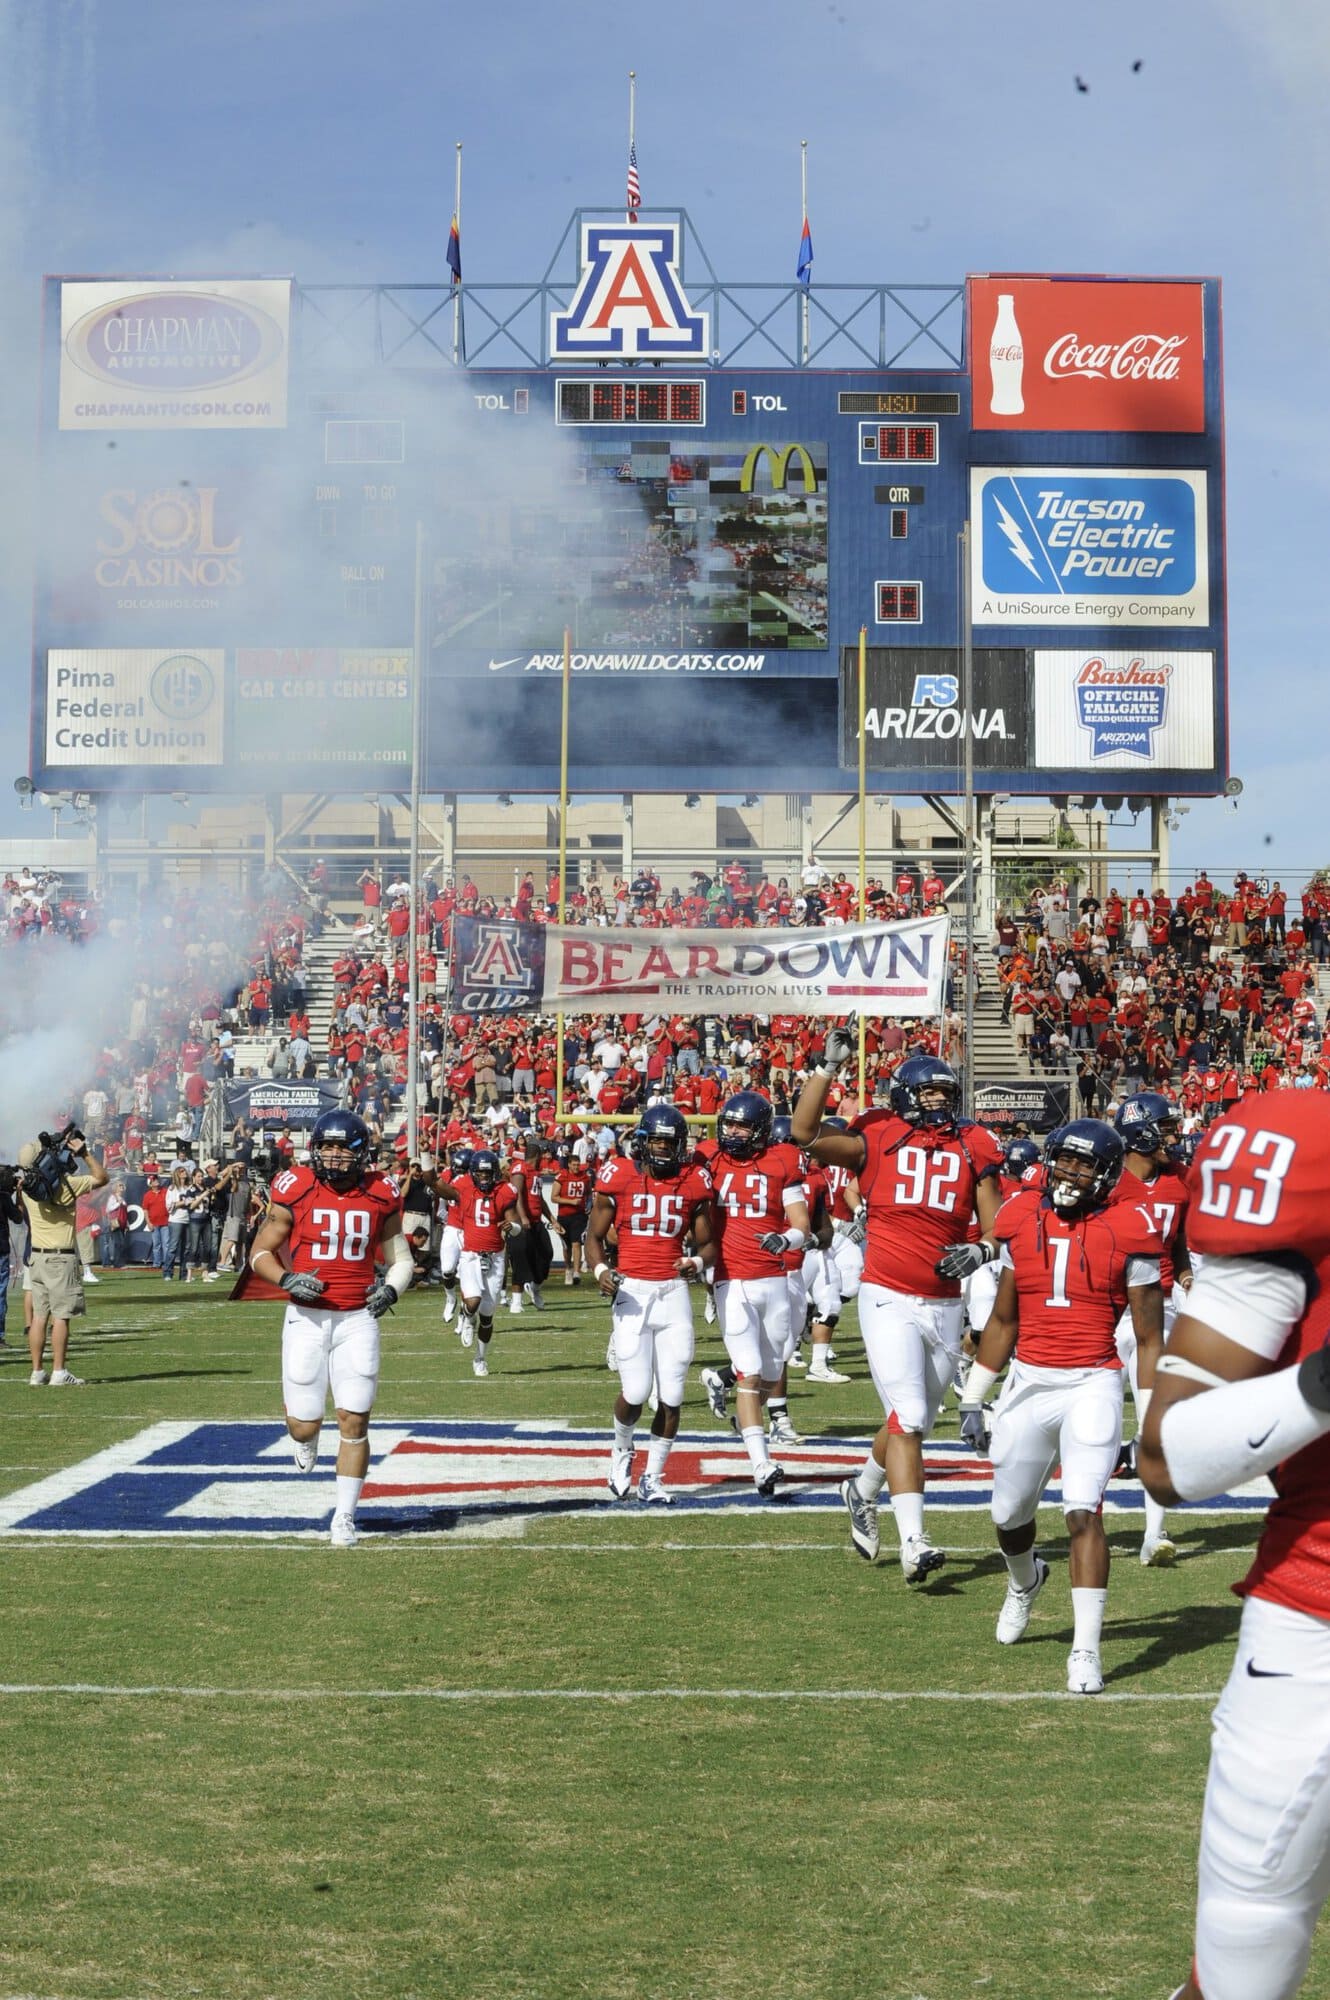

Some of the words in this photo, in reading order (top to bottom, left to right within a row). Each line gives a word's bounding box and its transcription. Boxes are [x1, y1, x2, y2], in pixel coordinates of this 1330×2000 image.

[550, 223, 709, 358] A
[103, 317, 245, 354] CHAPMAN
[107, 354, 241, 369] AUTOMOTIVE
[1043, 332, 1189, 380] Coca-Cola
[74, 402, 271, 417] CHAPMANTUCSON.COM
[473, 394, 511, 410] TOL
[752, 396, 787, 412] TOL
[878, 395, 917, 412] WSU
[363, 485, 377, 500] TO
[380, 485, 396, 501] GO
[888, 487, 910, 503] QTR
[1036, 489, 1145, 520] Tucson
[96, 486, 244, 556] SOL
[1047, 520, 1175, 549] Electric
[94, 558, 245, 588] CASINOS
[341, 565, 367, 581] BALL
[369, 565, 385, 581] ON
[1060, 549, 1175, 578] Power
[982, 603, 992, 614] A
[997, 602, 1070, 614] UniSource
[1075, 603, 1124, 618] Energy
[1129, 603, 1195, 619] Company
[524, 654, 766, 672] ARIZONAWILDCATS.COM
[56, 667, 116, 688] Pima
[240, 680, 275, 698] CAR
[333, 679, 408, 698] CENTERS
[1084, 690, 1159, 702] OFFICIAL
[56, 697, 144, 718] Federal
[1084, 703, 1159, 714] TAILGATE
[857, 708, 1007, 739] ARIZONA
[1084, 715, 1159, 723] HEADQUARTERS
[55, 728, 129, 748] Credit
[135, 728, 206, 748] Union
[1097, 732, 1146, 742] ARIZONA
[665, 985, 693, 996] THE
[697, 985, 778, 996] TRADITION
[783, 985, 822, 996] LIVES
[895, 1146, 961, 1213] 92
[1199, 1124, 1297, 1226] 23
[382, 1175, 401, 1198] 3
[567, 1181, 585, 1197] 63
[717, 1173, 768, 1218] 43
[474, 1198, 491, 1228] 6
[631, 1193, 683, 1238] 26
[311, 1208, 371, 1262] 38
[1045, 1237, 1071, 1307] 1
